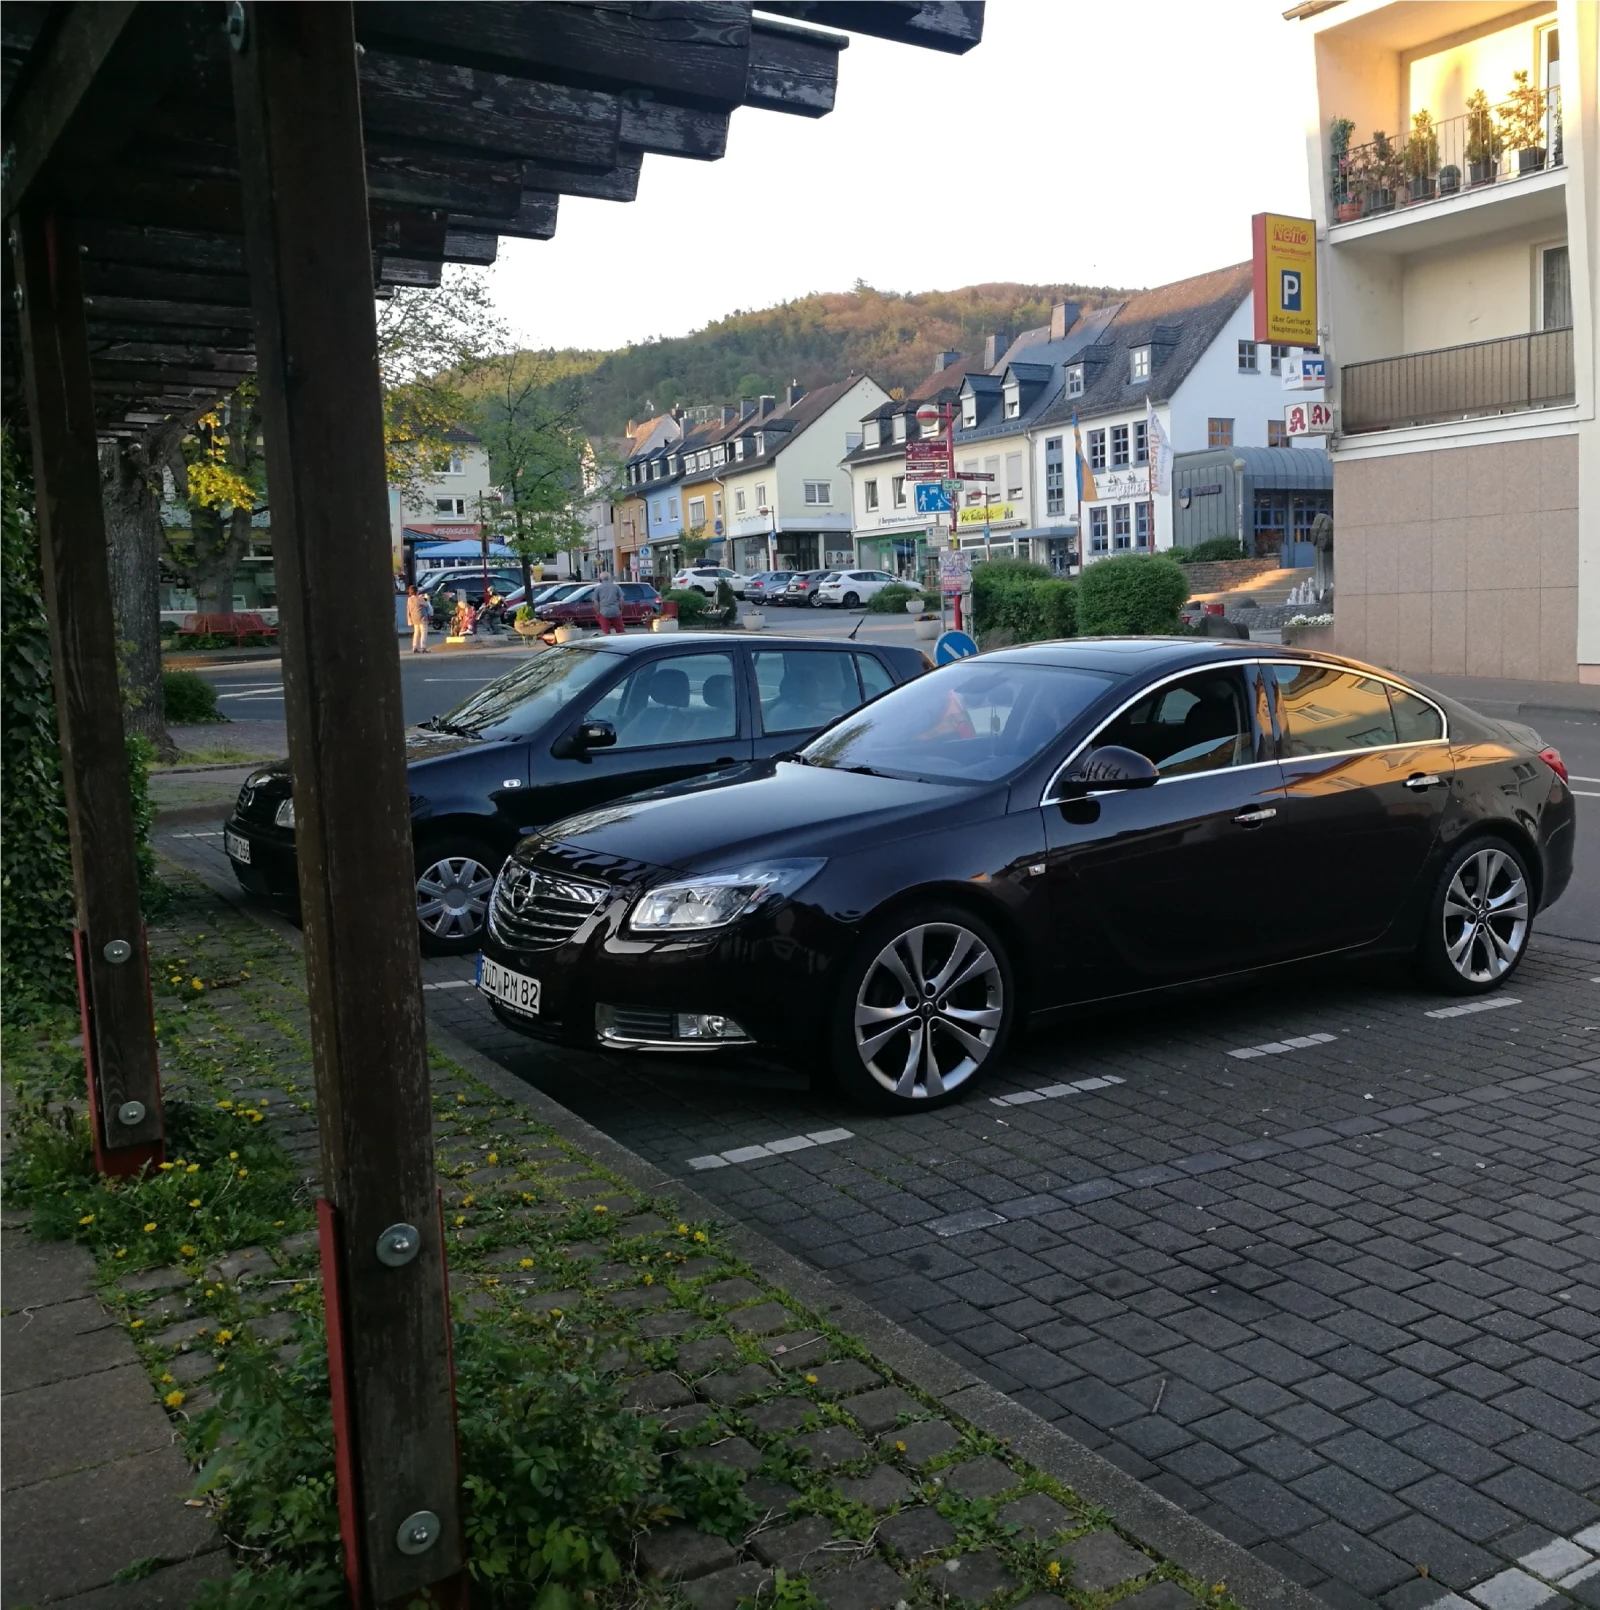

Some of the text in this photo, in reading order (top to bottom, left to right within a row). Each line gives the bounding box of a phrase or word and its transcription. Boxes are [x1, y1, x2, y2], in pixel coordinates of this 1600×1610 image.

[1273, 224, 1309, 245] Netto
[1283, 274, 1299, 306] P
[1272, 315, 1285, 323] über
[503, 971, 519, 1002] PM
[521, 979, 539, 1010] 82
